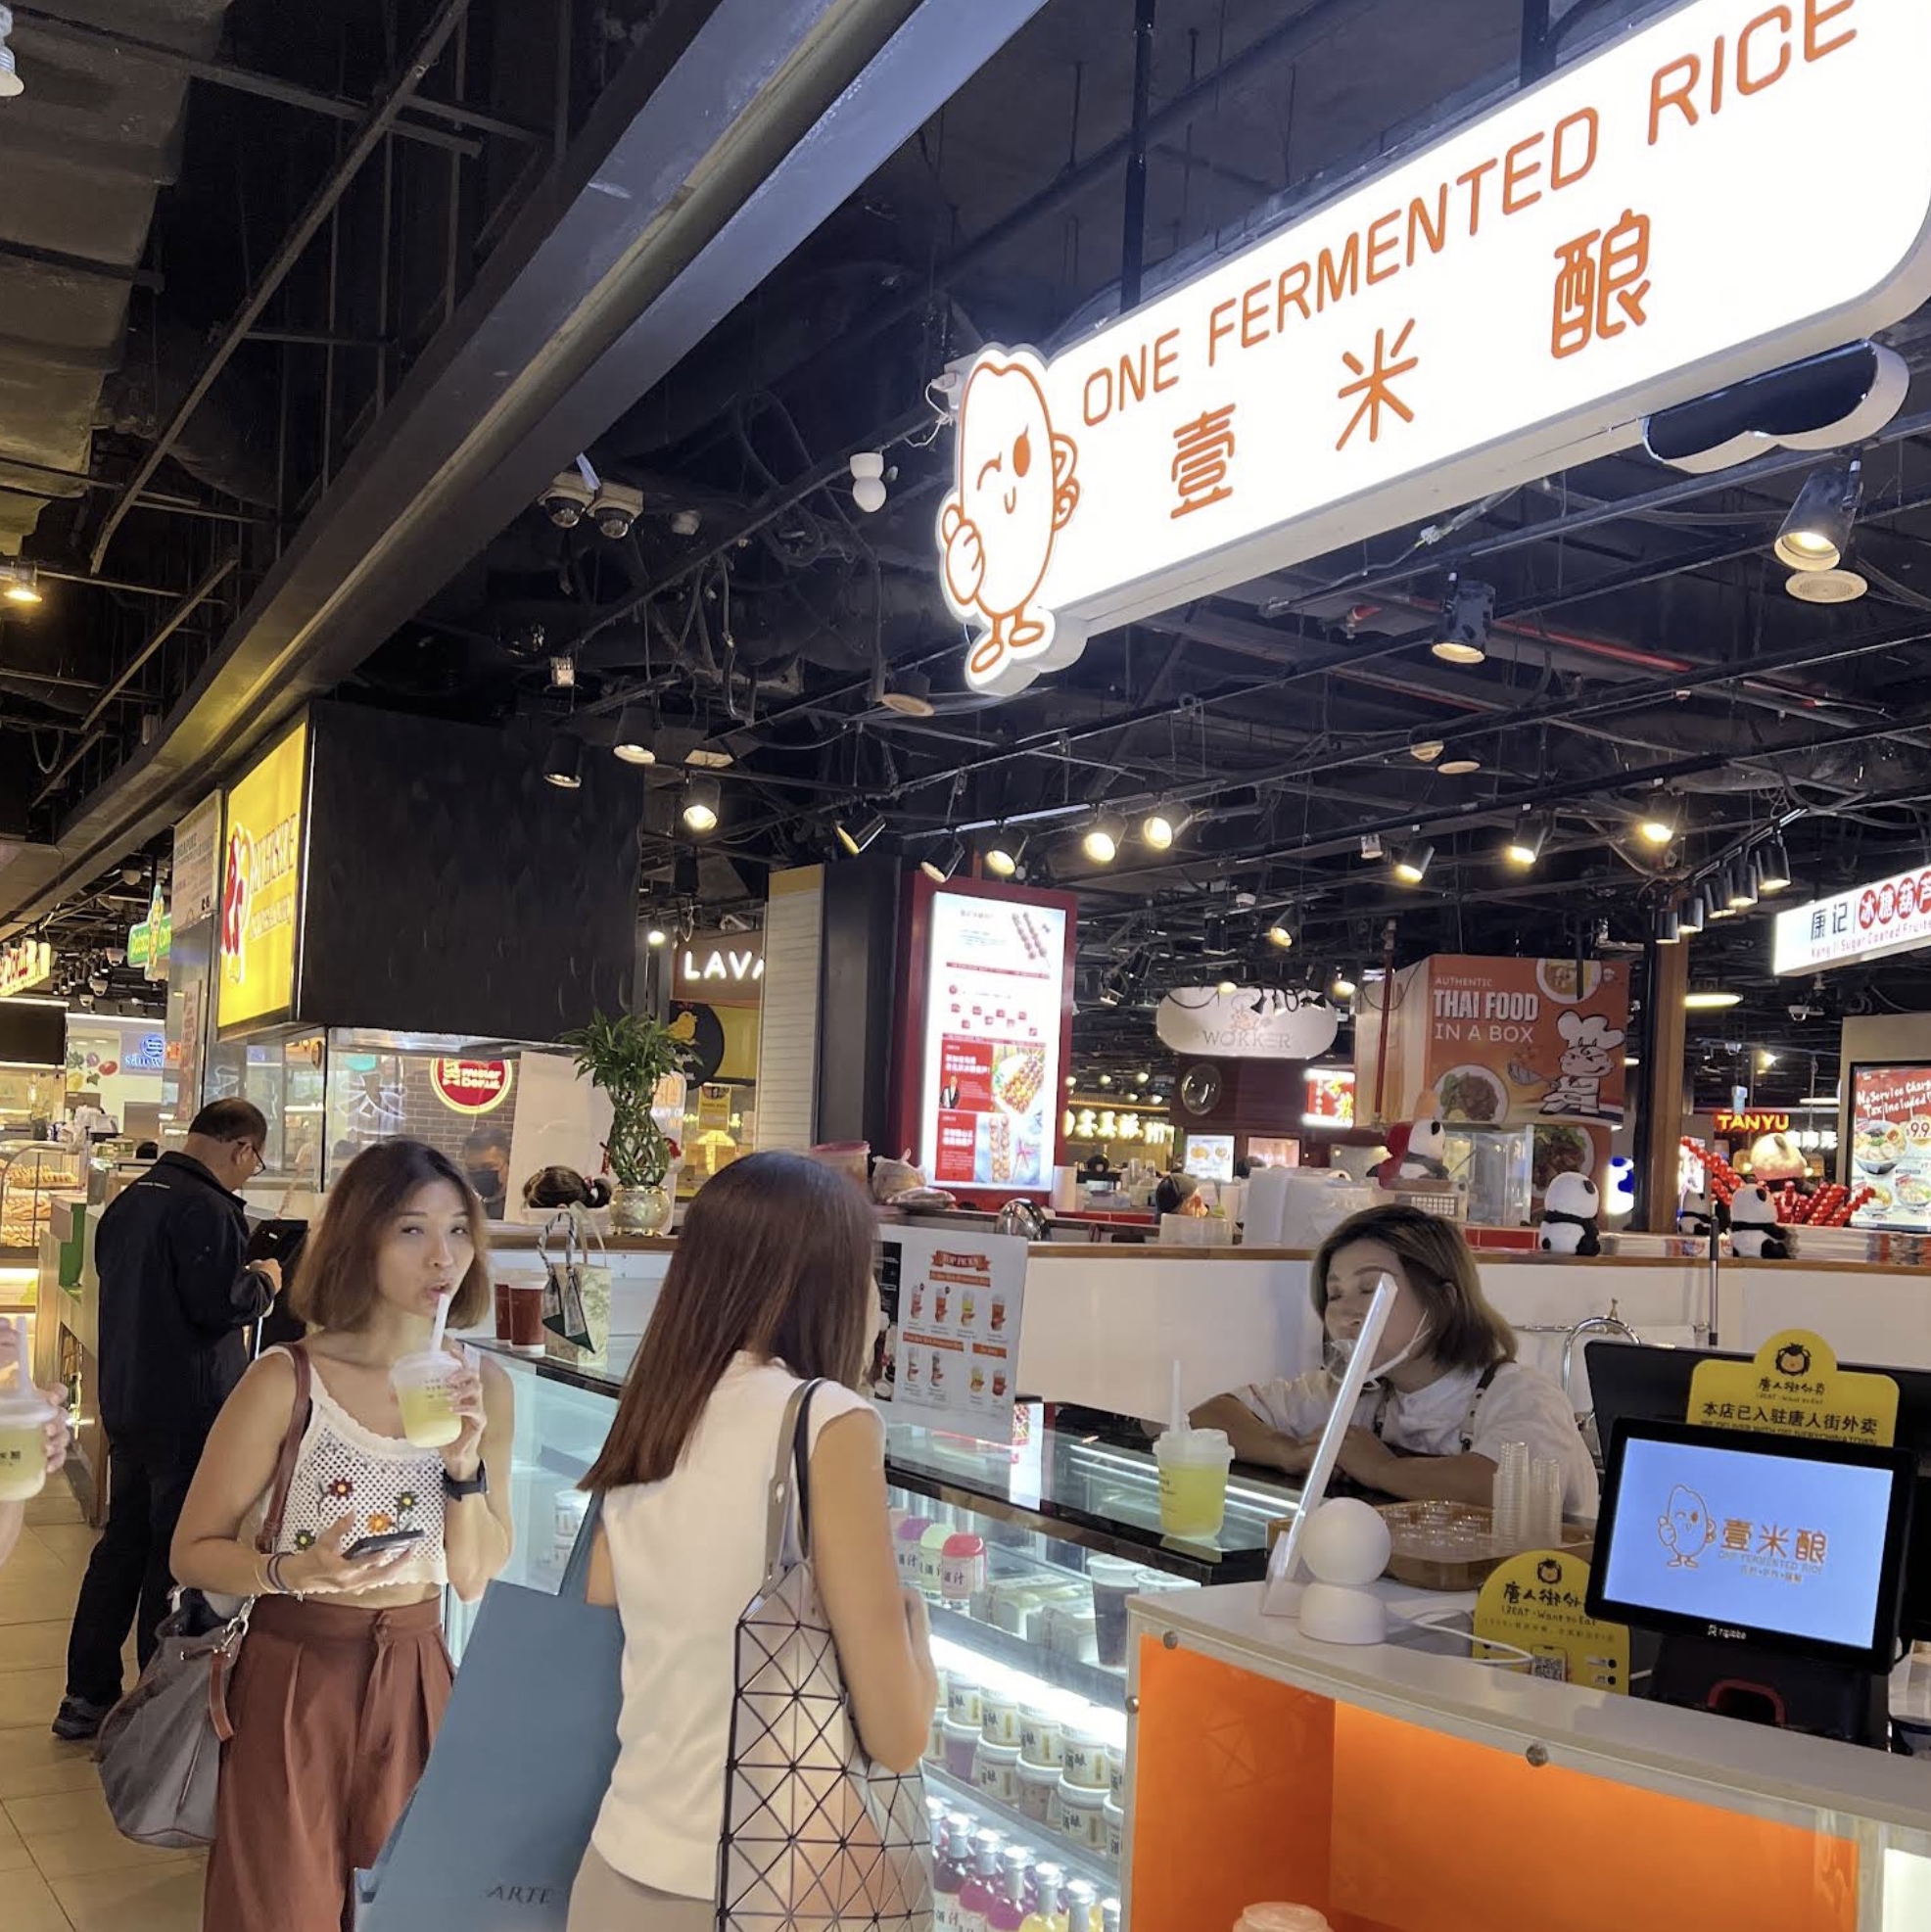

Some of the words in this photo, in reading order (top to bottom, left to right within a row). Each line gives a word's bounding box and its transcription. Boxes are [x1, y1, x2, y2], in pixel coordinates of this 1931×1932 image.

[1082, 329, 1180, 427] ONE
[1208, 108, 1599, 364] FERMENTED
[1648, 0, 1858, 143] RICE
[1170, 210, 1651, 520] 壹米酿
[1435, 976, 1492, 987] AUTHENTIC
[1433, 989, 1480, 1019] THAI
[1485, 992, 1538, 1021] FOOD
[1435, 1023, 1460, 1041] IN
[1468, 1025, 1482, 1041] A
[1488, 1026, 1533, 1044] BOX
[1717, 1114, 1789, 1130] TANYU
[1702, 1401, 1878, 1436] 本店已入驻唐人街外卖
[1719, 1518, 1826, 1565] 壹米酿
[488, 1884, 553, 1905] ARTE
